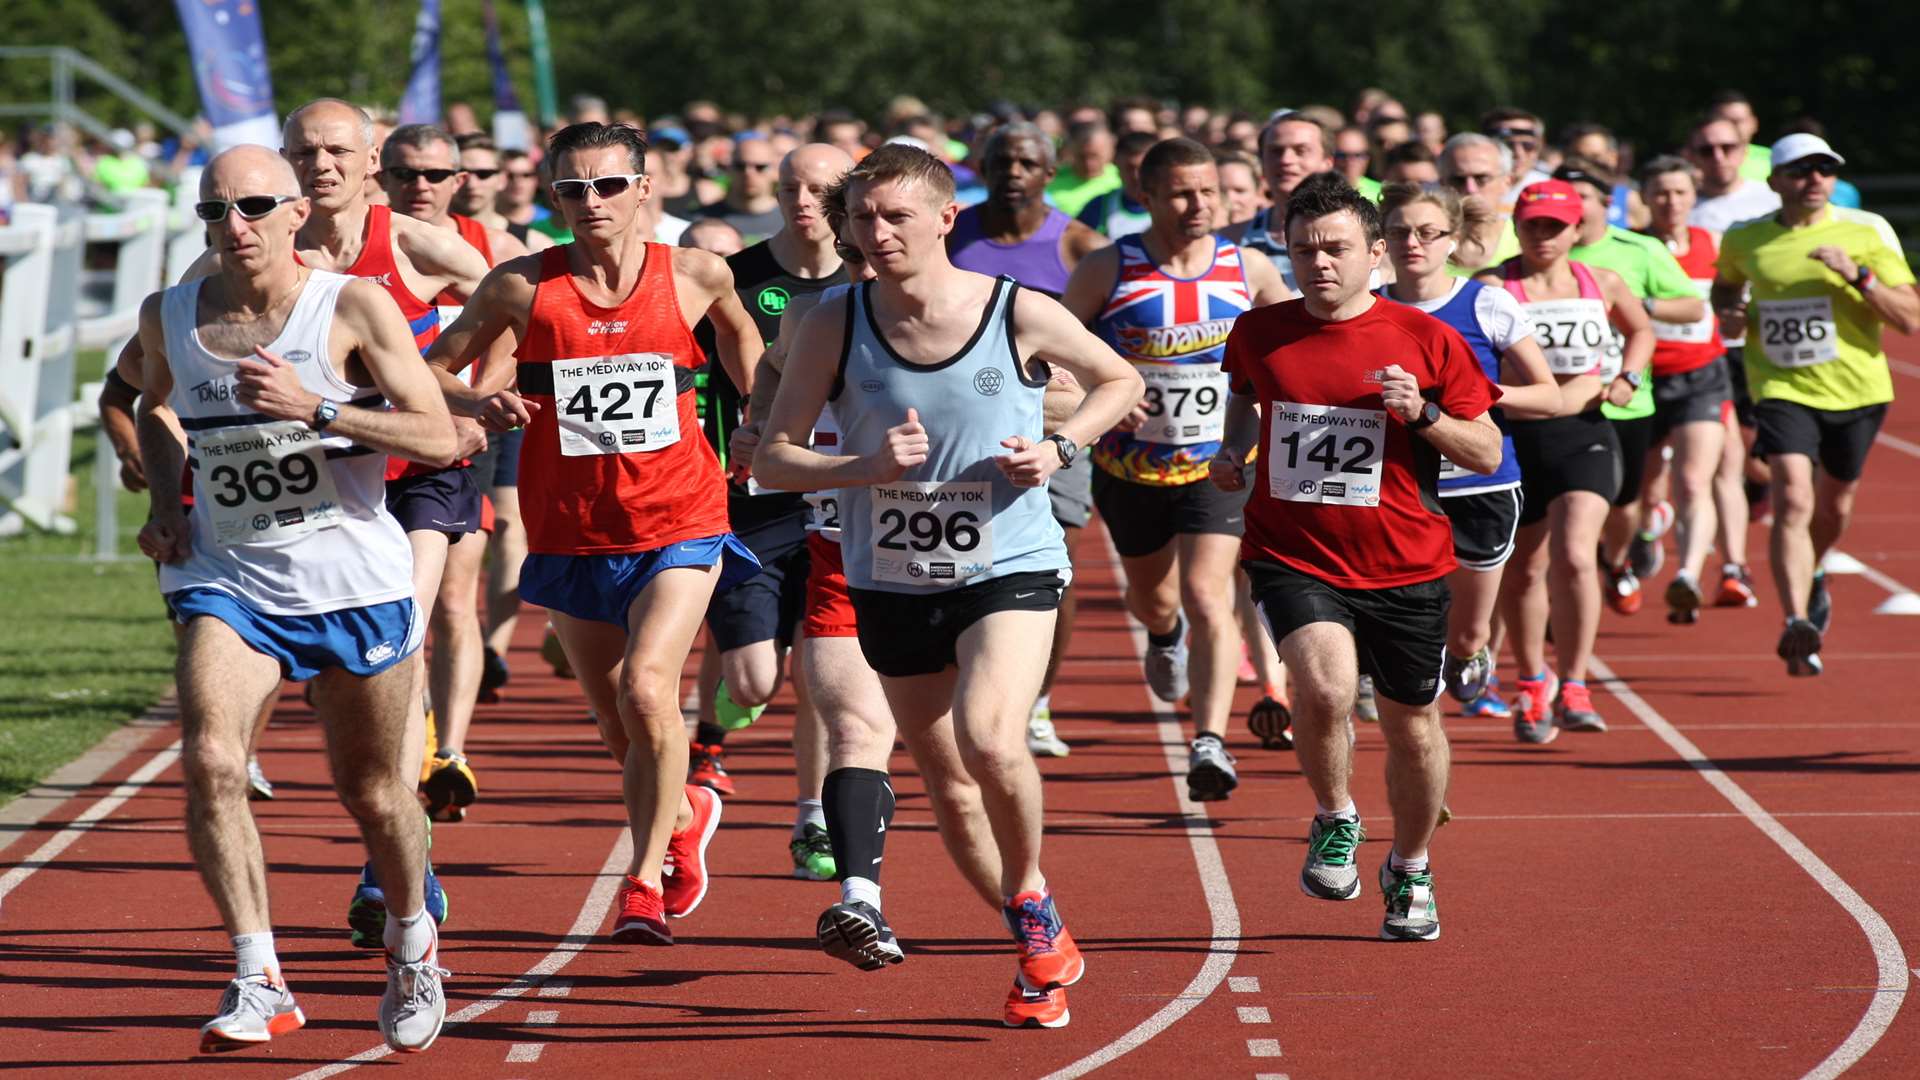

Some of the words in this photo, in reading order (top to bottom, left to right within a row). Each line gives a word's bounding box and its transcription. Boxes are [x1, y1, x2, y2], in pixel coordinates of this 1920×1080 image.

[1536, 320, 1602, 349] 370
[1764, 315, 1826, 345] 286
[560, 367, 584, 378] THE
[586, 362, 643, 376] MEDWAY
[646, 360, 668, 372] 10K
[565, 379, 665, 423] 427
[1144, 386, 1218, 418] 379
[1279, 411, 1299, 423] THE
[1301, 413, 1358, 428] MEDWAY
[1359, 419, 1381, 430] 10K
[202, 445, 224, 458] THE
[224, 435, 284, 455] MEDWAY
[286, 430, 313, 443] 10K
[1281, 431, 1375, 475] 142
[210, 453, 318, 508] 369
[877, 488, 899, 500] THE
[900, 490, 958, 502] MEDWAY
[960, 491, 985, 502] 10K
[877, 508, 981, 553] 296
